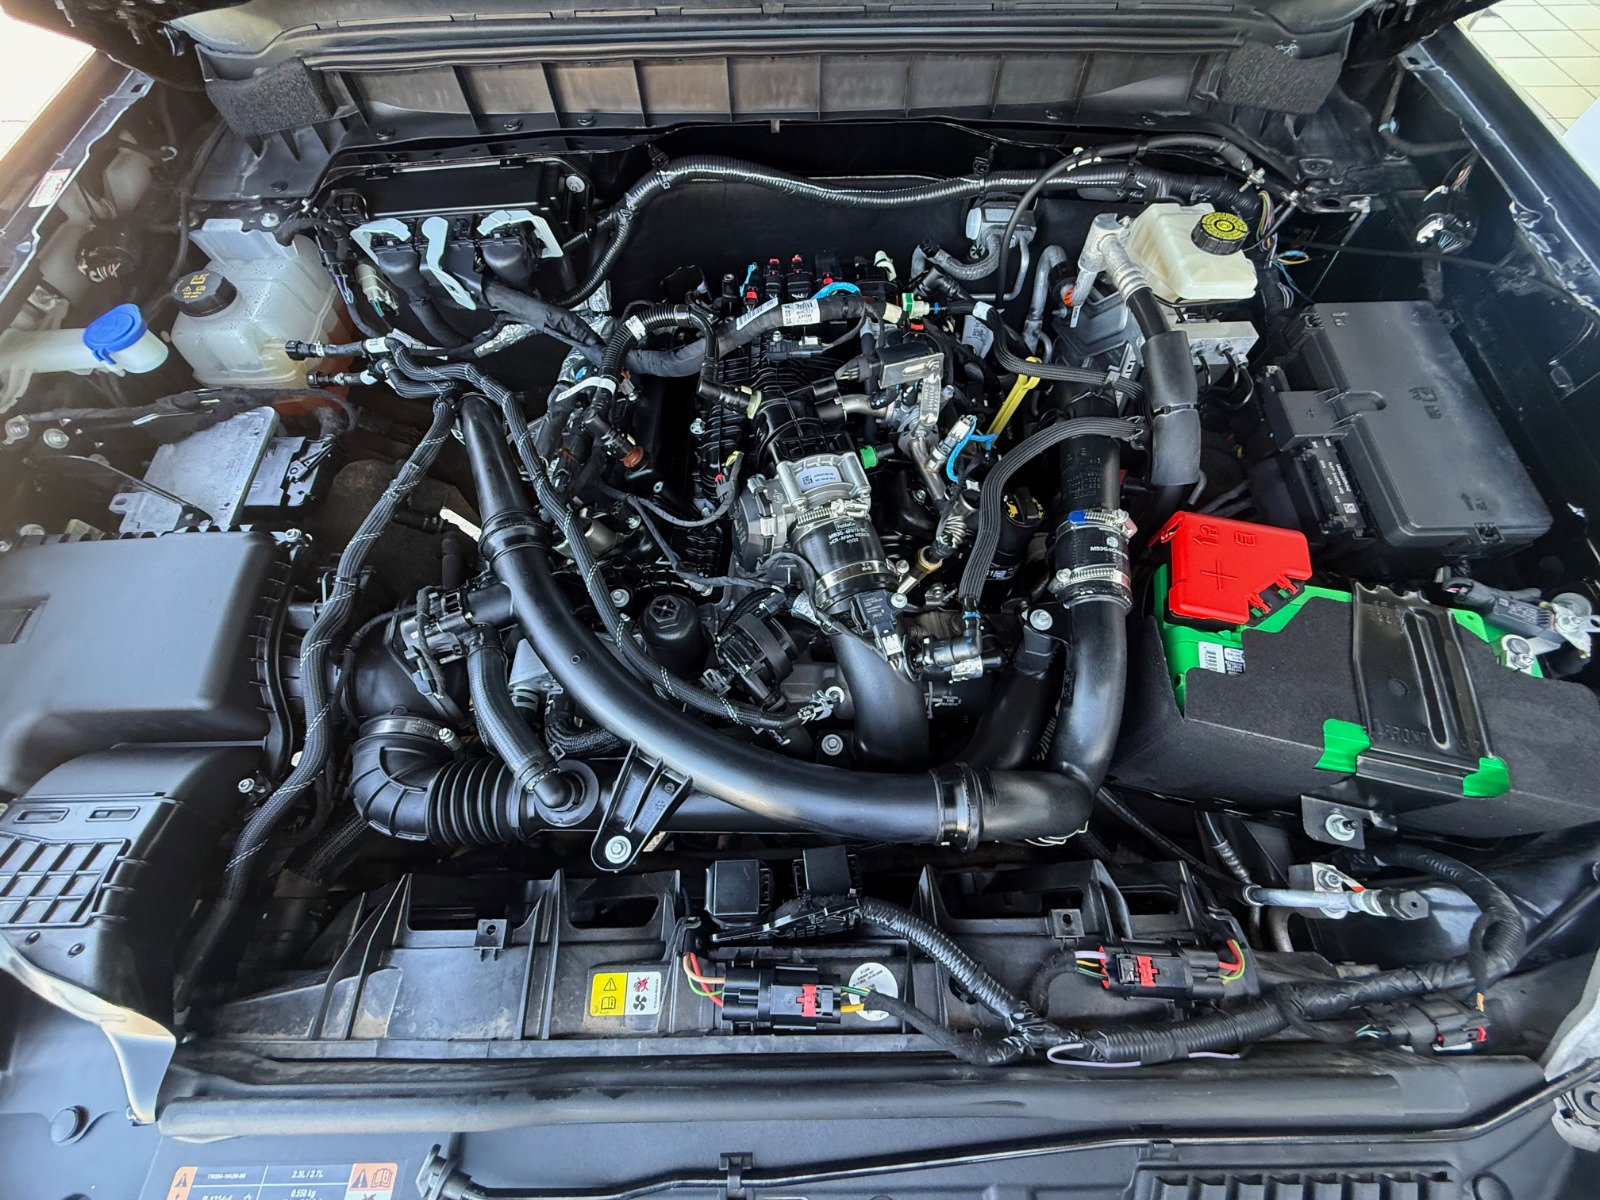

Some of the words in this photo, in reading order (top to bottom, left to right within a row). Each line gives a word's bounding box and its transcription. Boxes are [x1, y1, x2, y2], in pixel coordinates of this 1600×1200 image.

[291, 1169, 305, 1178] 2.3L
[310, 1169, 323, 1178] 2.7L
[290, 1188, 307, 1198] 0.550
[307, 1188, 316, 1199] kg
